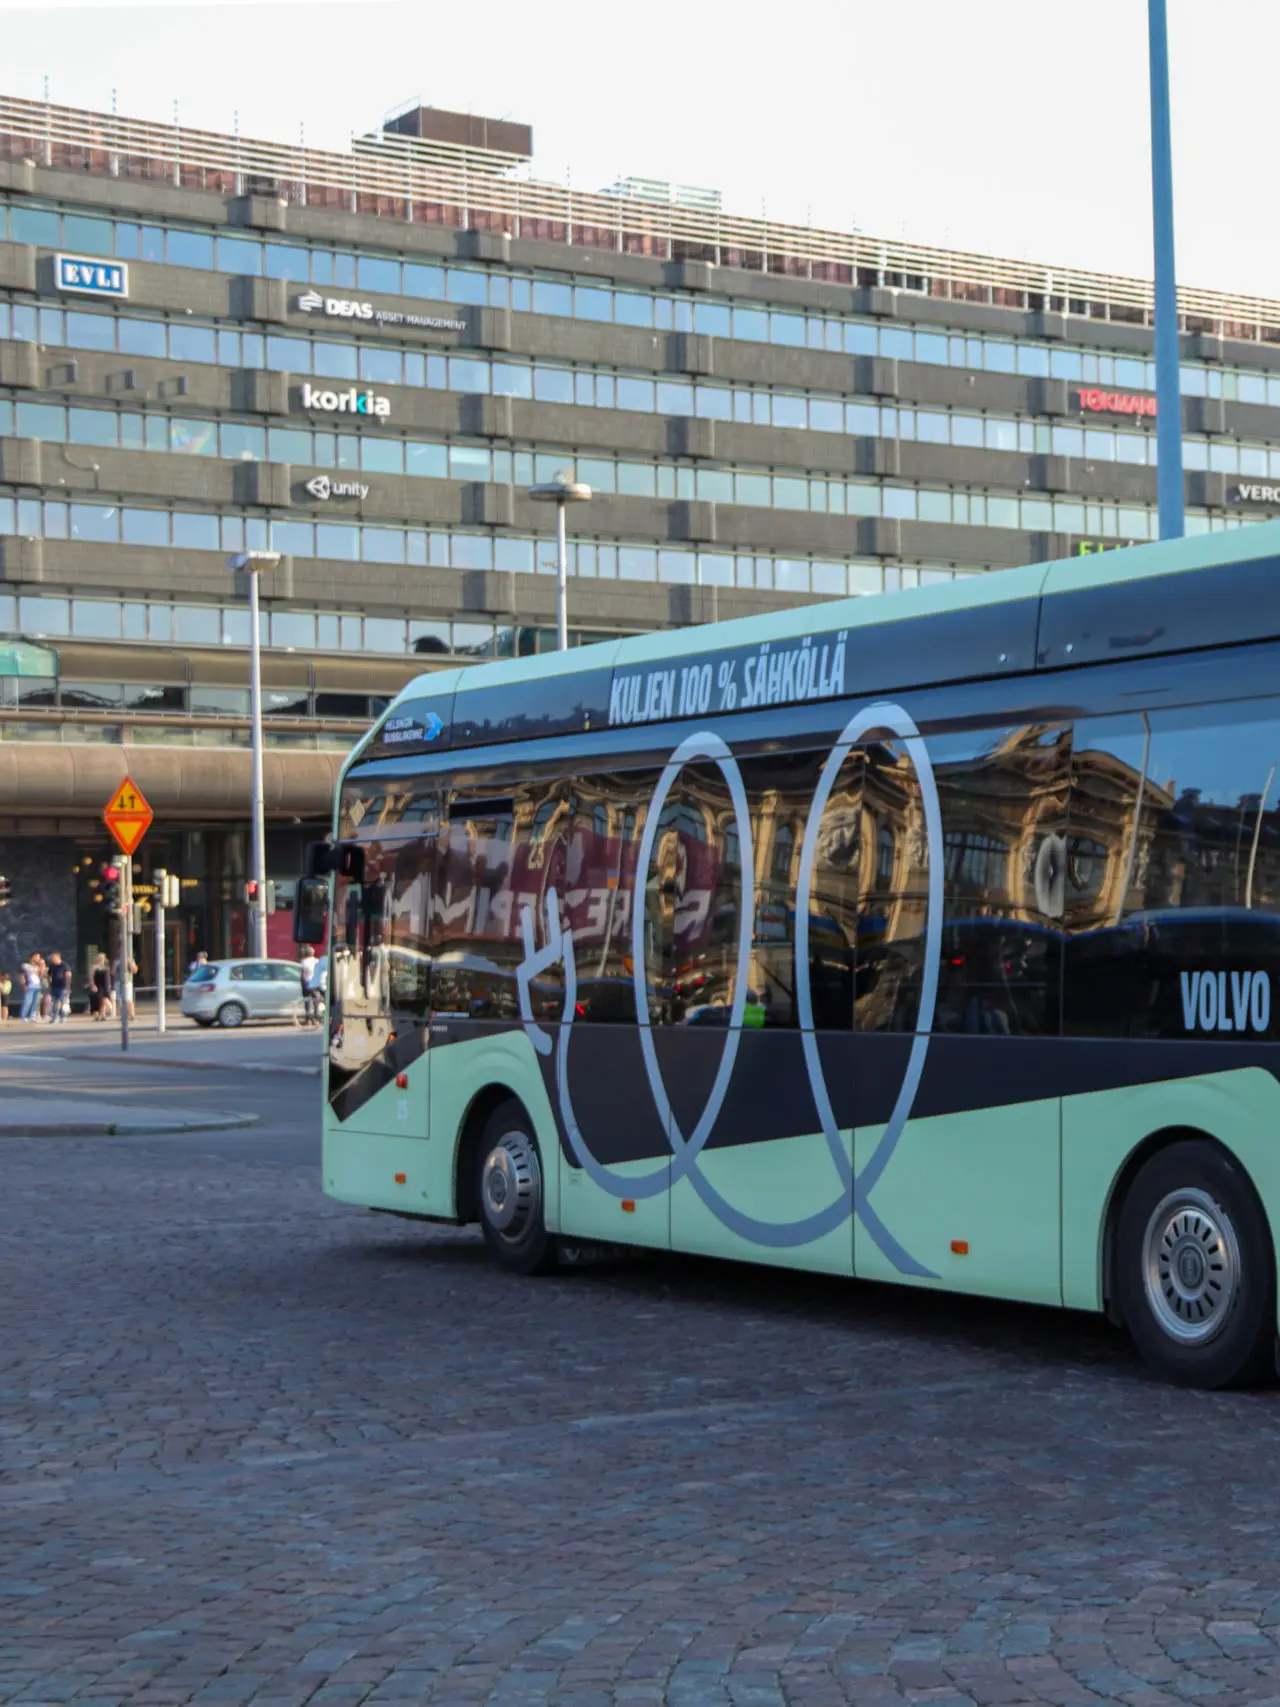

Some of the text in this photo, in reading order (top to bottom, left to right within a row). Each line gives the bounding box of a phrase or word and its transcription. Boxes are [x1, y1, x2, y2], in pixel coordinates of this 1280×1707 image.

[64, 264, 122, 290] EVLI
[326, 298, 467, 330] DEAS ASSET MANAGEMENT
[302, 383, 391, 416] korkia
[1076, 388, 1158, 416] TOKMAN
[333, 480, 369, 500] unity
[608, 630, 848, 726] KULJEN 100 % SÄHKÖLLÄ
[1180, 970, 1270, 1031] VOLVO
